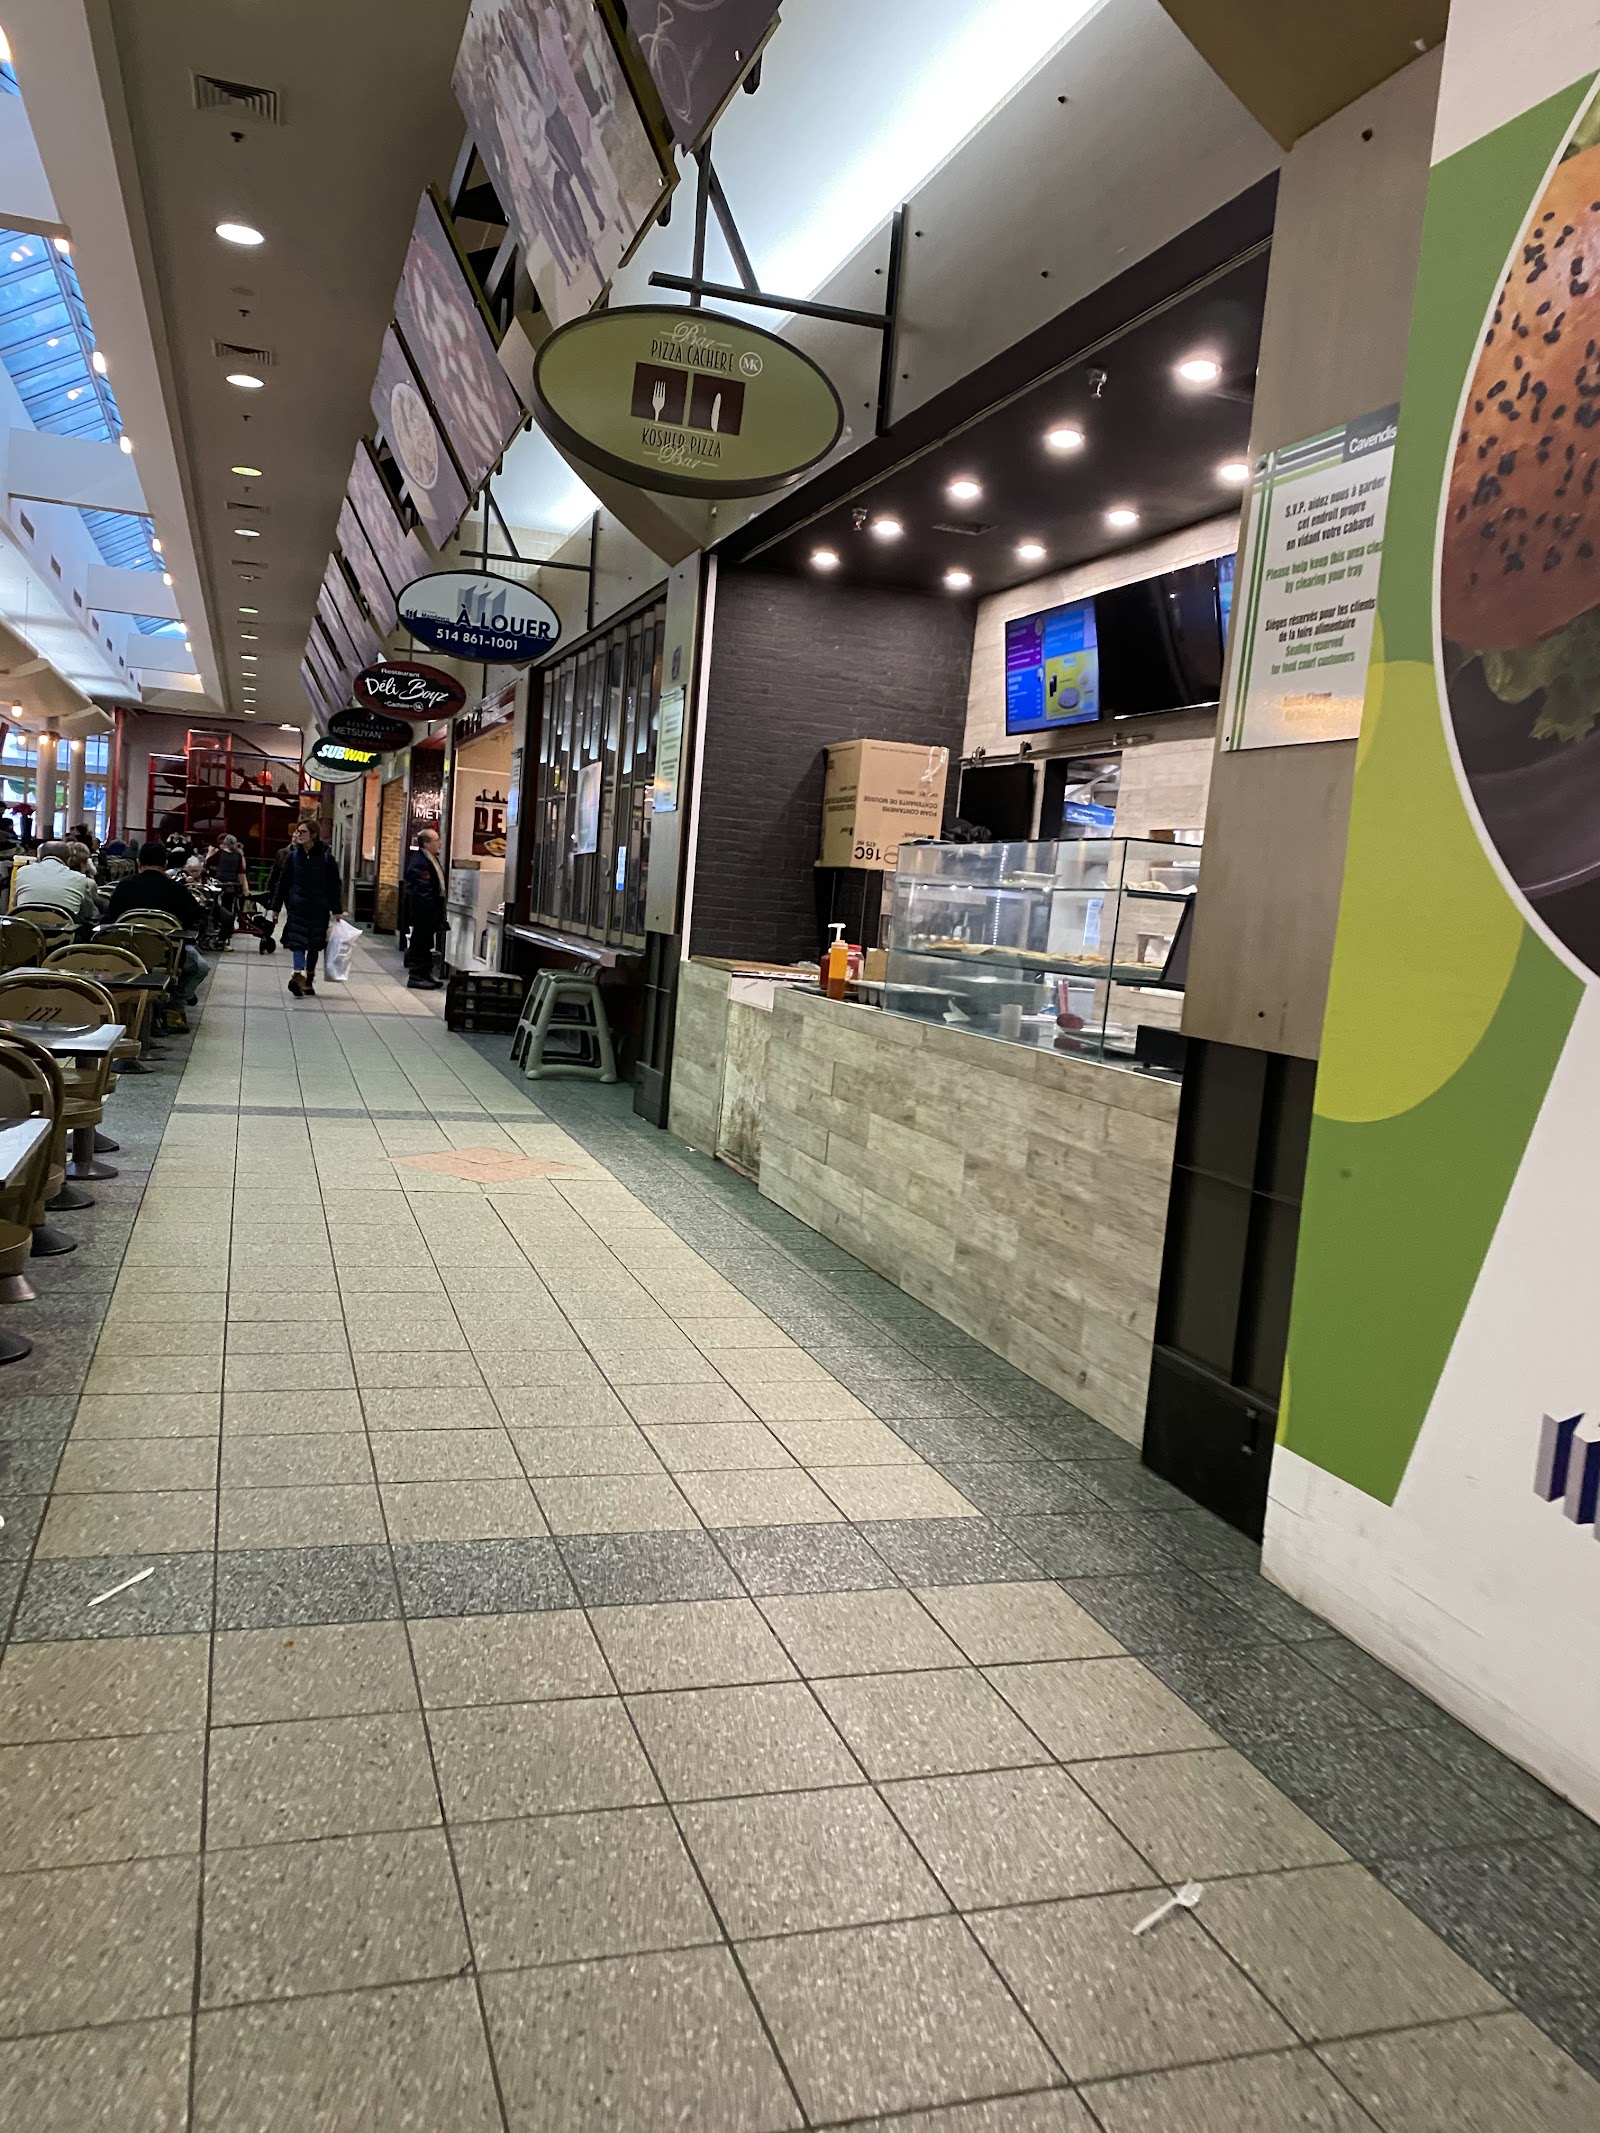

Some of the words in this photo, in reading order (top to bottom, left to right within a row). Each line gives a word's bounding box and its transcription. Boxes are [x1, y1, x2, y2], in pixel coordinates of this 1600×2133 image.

[672, 321, 715, 348] Bar
[651, 339, 682, 363] PIZZA
[641, 427, 686, 450] KOSHER
[689, 436, 721, 458] PIZZA
[658, 443, 700, 468] Bar
[1285, 500, 1306, 518] S.V.P.
[1308, 495, 1329, 511] aidez
[1330, 488, 1350, 505] nous
[1351, 484, 1357, 498] à
[1358, 476, 1386, 497] garder
[1297, 515, 1310, 531] cet
[1311, 507, 1338, 526] endroit
[1340, 500, 1367, 520] propre
[1286, 539, 1296, 551] en
[1297, 530, 1320, 548] vidant
[1322, 525, 1342, 541] votre
[1343, 514, 1375, 535] cabaret
[1266, 566, 1291, 581] Please
[1291, 561, 1309, 574] help
[1309, 555, 1328, 569] keep
[1330, 550, 1345, 565] this
[1346, 545, 1364, 560] area
[1285, 581, 1294, 594] by
[1295, 573, 1327, 591] clearing
[1327, 568, 1346, 584] your
[1347, 563, 1364, 577] tray
[454, 603, 472, 629] À
[480, 612, 552, 641] LOUER
[1319, 607, 1336, 621] pour
[1337, 604, 1349, 616] les
[1350, 598, 1376, 613] clients
[436, 628, 459, 641] 514
[463, 633, 518, 650] 861-1001
[1279, 631, 1288, 643] de
[1289, 629, 1295, 641] la
[1296, 626, 1313, 639] foire
[1313, 618, 1356, 635] alimentaire
[1312, 635, 1344, 652] reserved
[381, 667, 420, 678] Restaurant
[365, 677, 399, 696] Déli
[399, 678, 449, 708] Boyz
[332, 726, 382, 739] METSUYAN
[317, 744, 377, 763] SUBWAY
[854, 846, 882, 861] 16C
